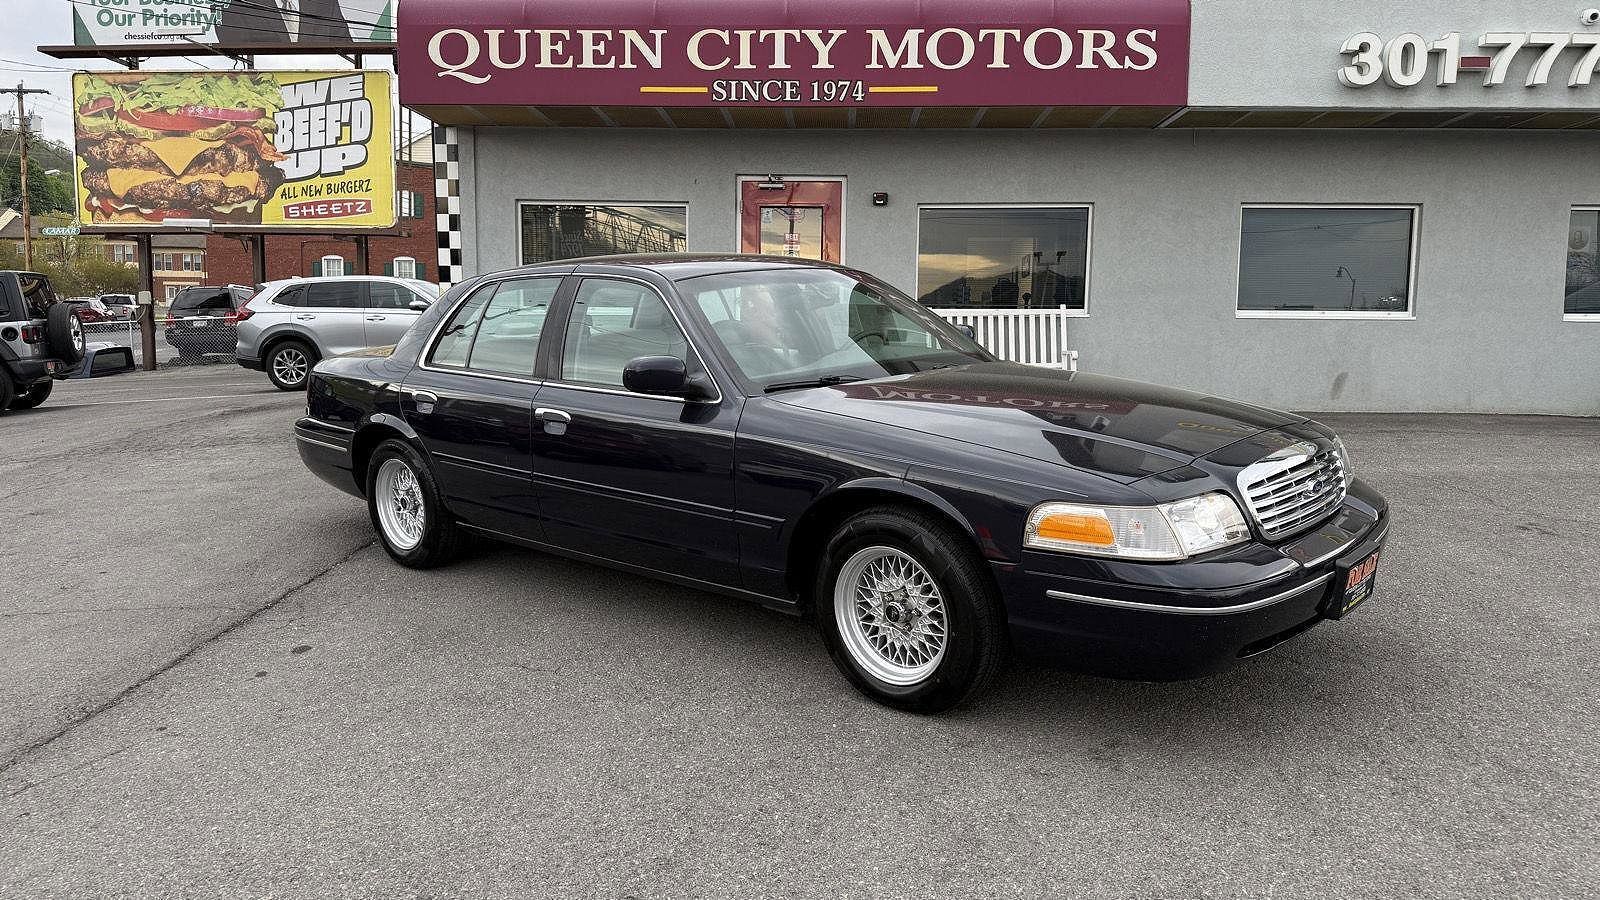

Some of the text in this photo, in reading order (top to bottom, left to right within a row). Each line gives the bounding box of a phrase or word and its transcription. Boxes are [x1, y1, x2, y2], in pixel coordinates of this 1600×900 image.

[96, 8, 136, 27] Our
[428, 28, 1158, 84] QUEEN CITY MOTORS
[280, 74, 364, 109] WE
[712, 80, 865, 102] SINCE 1974
[274, 99, 372, 153] BEEF'D
[275, 144, 368, 181] UP
[280, 179, 372, 200] ALL NEW BURGERZ
[288, 201, 367, 217] SHEETZ
